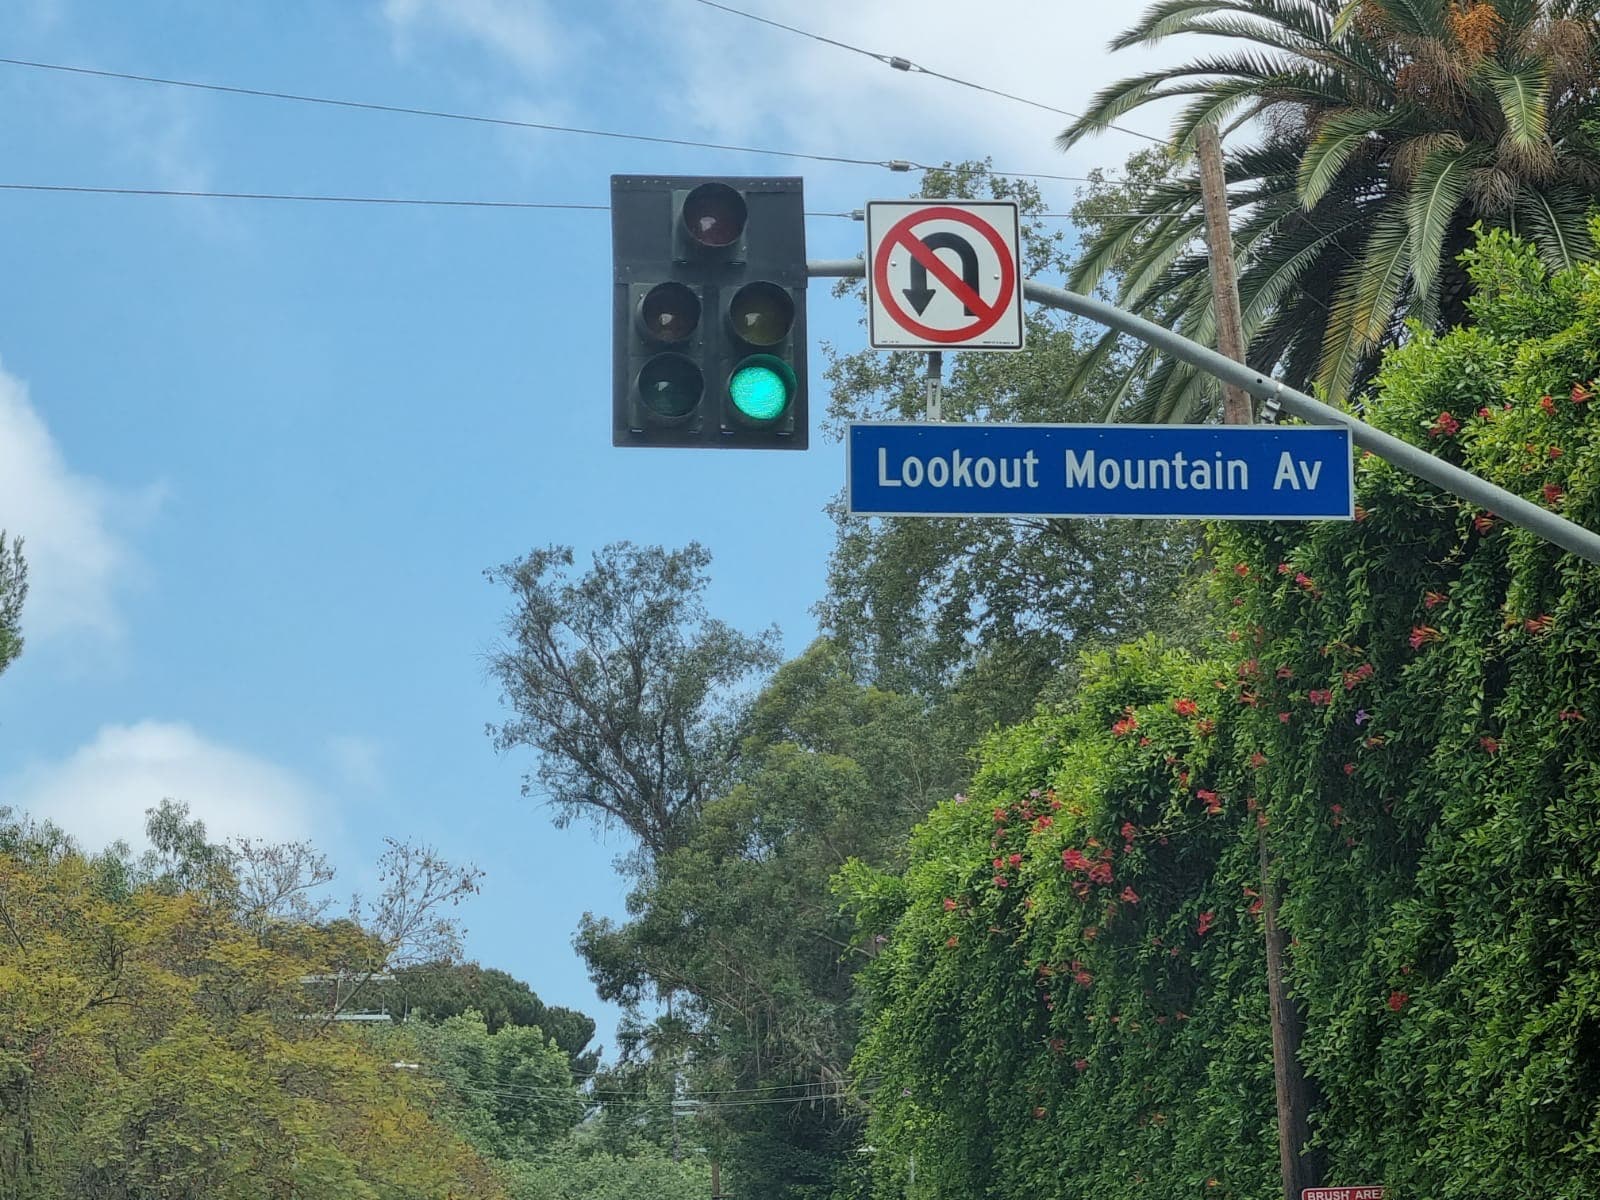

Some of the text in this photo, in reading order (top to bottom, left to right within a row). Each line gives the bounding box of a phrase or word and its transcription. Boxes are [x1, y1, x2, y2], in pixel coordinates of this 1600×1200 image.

[878, 447, 1322, 490] Lookout Mountain Av
[1307, 1190, 1350, 1200] BRUSH
